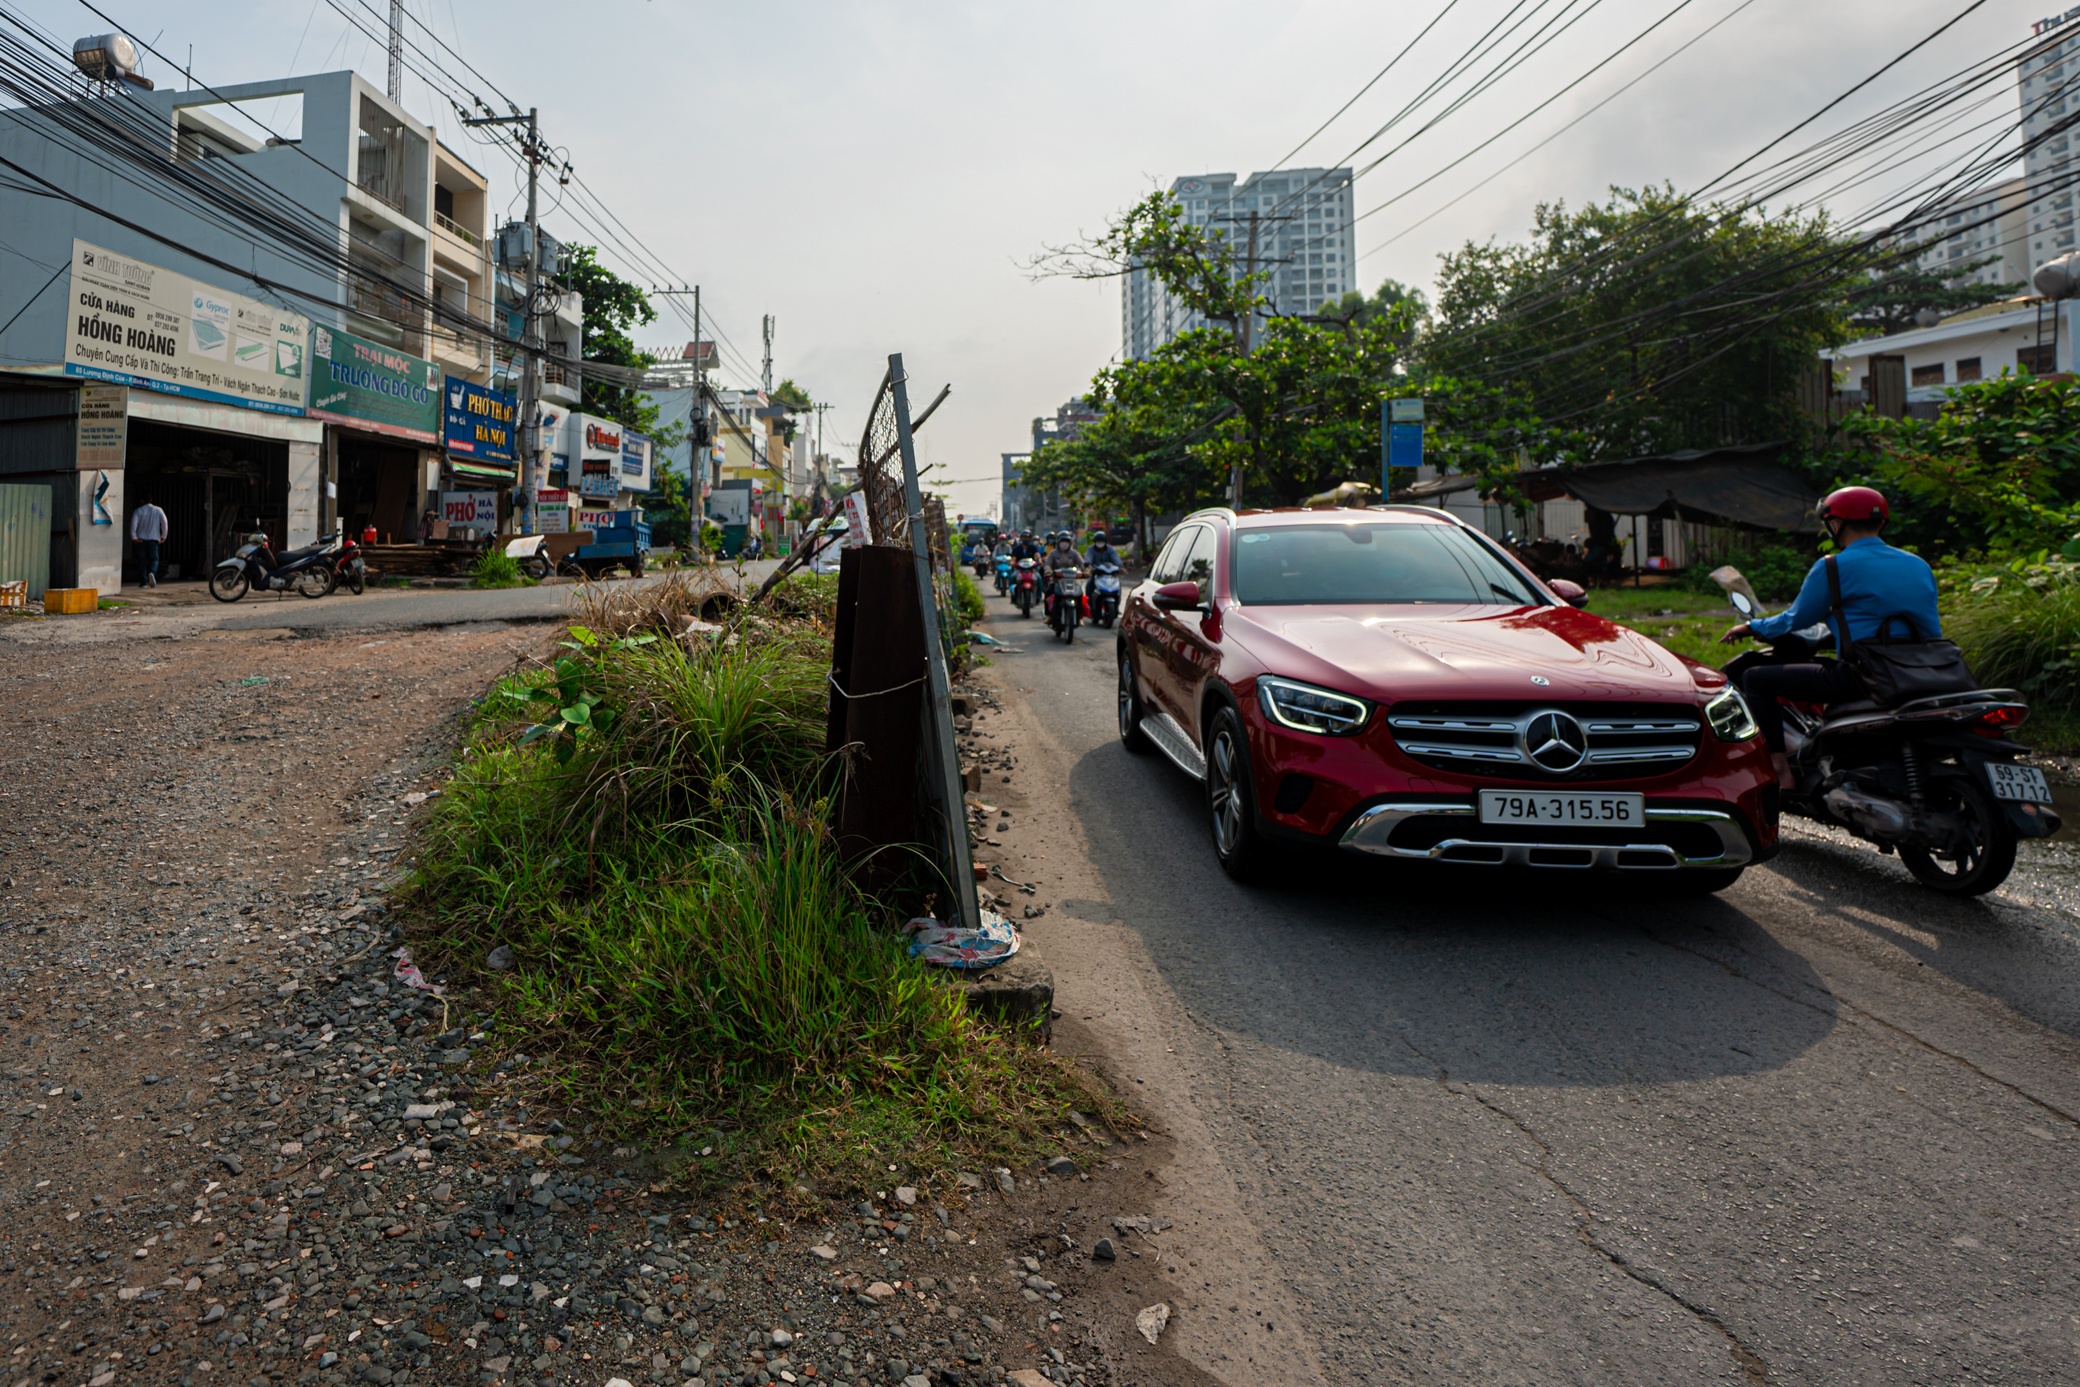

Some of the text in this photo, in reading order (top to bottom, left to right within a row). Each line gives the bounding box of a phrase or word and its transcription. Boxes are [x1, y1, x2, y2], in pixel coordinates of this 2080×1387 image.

[98, 255, 120, 276] VĨNH
[80, 292, 135, 318] CỬA HÀNG
[206, 300, 229, 315] Gyproc
[78, 312, 176, 357] HỒNG HOÀNG
[354, 344, 410, 374] TRẠI MỘC
[76, 344, 103, 361] Chuyên
[105, 350, 123, 367] Cung
[125, 354, 138, 370] Cấp
[140, 358, 148, 370] Và
[150, 360, 159, 372] Thi
[162, 363, 179, 379] Công:
[195, 370, 211, 386] Trang
[224, 376, 236, 388] Vách
[252, 383, 266, 395] Thạch
[267, 386, 276, 396] Cao
[279, 388, 288, 397] Sơn
[289, 391, 299, 401] Nước
[83, 368, 101, 378] Lương
[102, 371, 114, 380] Định
[391, 374, 409, 399] ĐỒ
[81, 410, 124, 419] HỒNG HOÀNG
[468, 390, 490, 416] PHỞ
[476, 421, 489, 442] HÀ
[490, 426, 506, 448] NỘI
[445, 493, 493, 522] PHỞ HÀ
[477, 511, 494, 522] NỘI
[1996, 782, 2050, 801] 317.12
[1494, 798, 1629, 820] 79A-315.56
